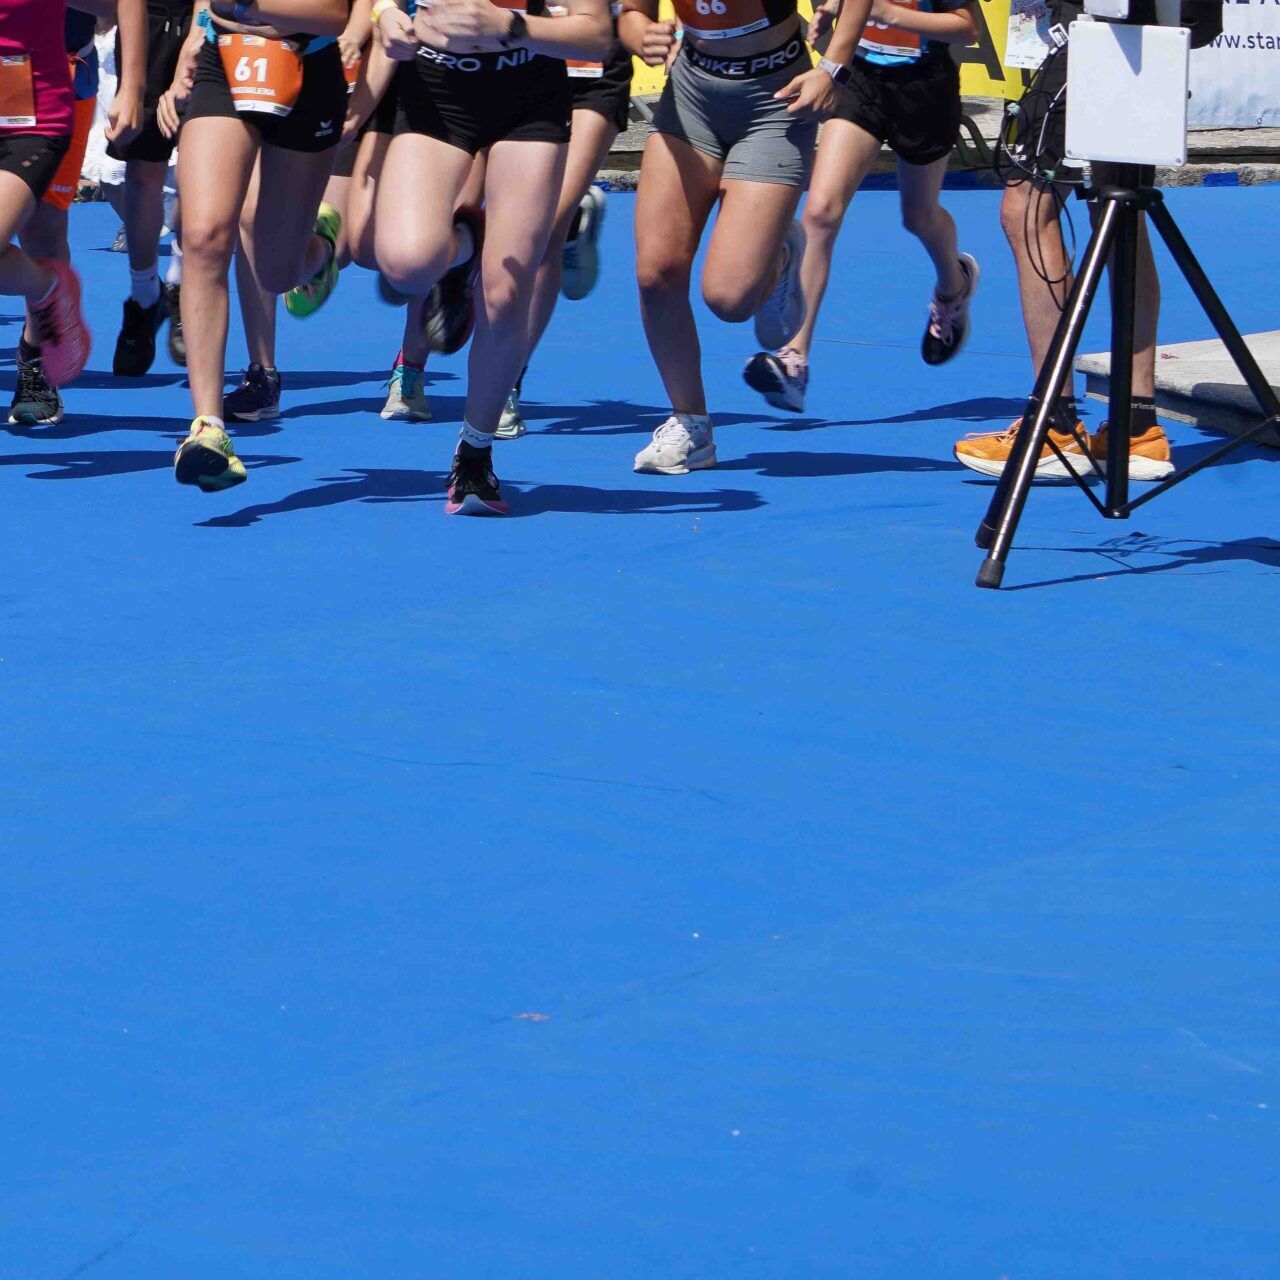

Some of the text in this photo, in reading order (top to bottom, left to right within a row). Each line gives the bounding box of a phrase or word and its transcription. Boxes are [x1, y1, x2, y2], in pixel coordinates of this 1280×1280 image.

[233, 55, 269, 83] 61
[416, 45, 482, 72] PRO
[692, 39, 801, 76] NIKE PRO
